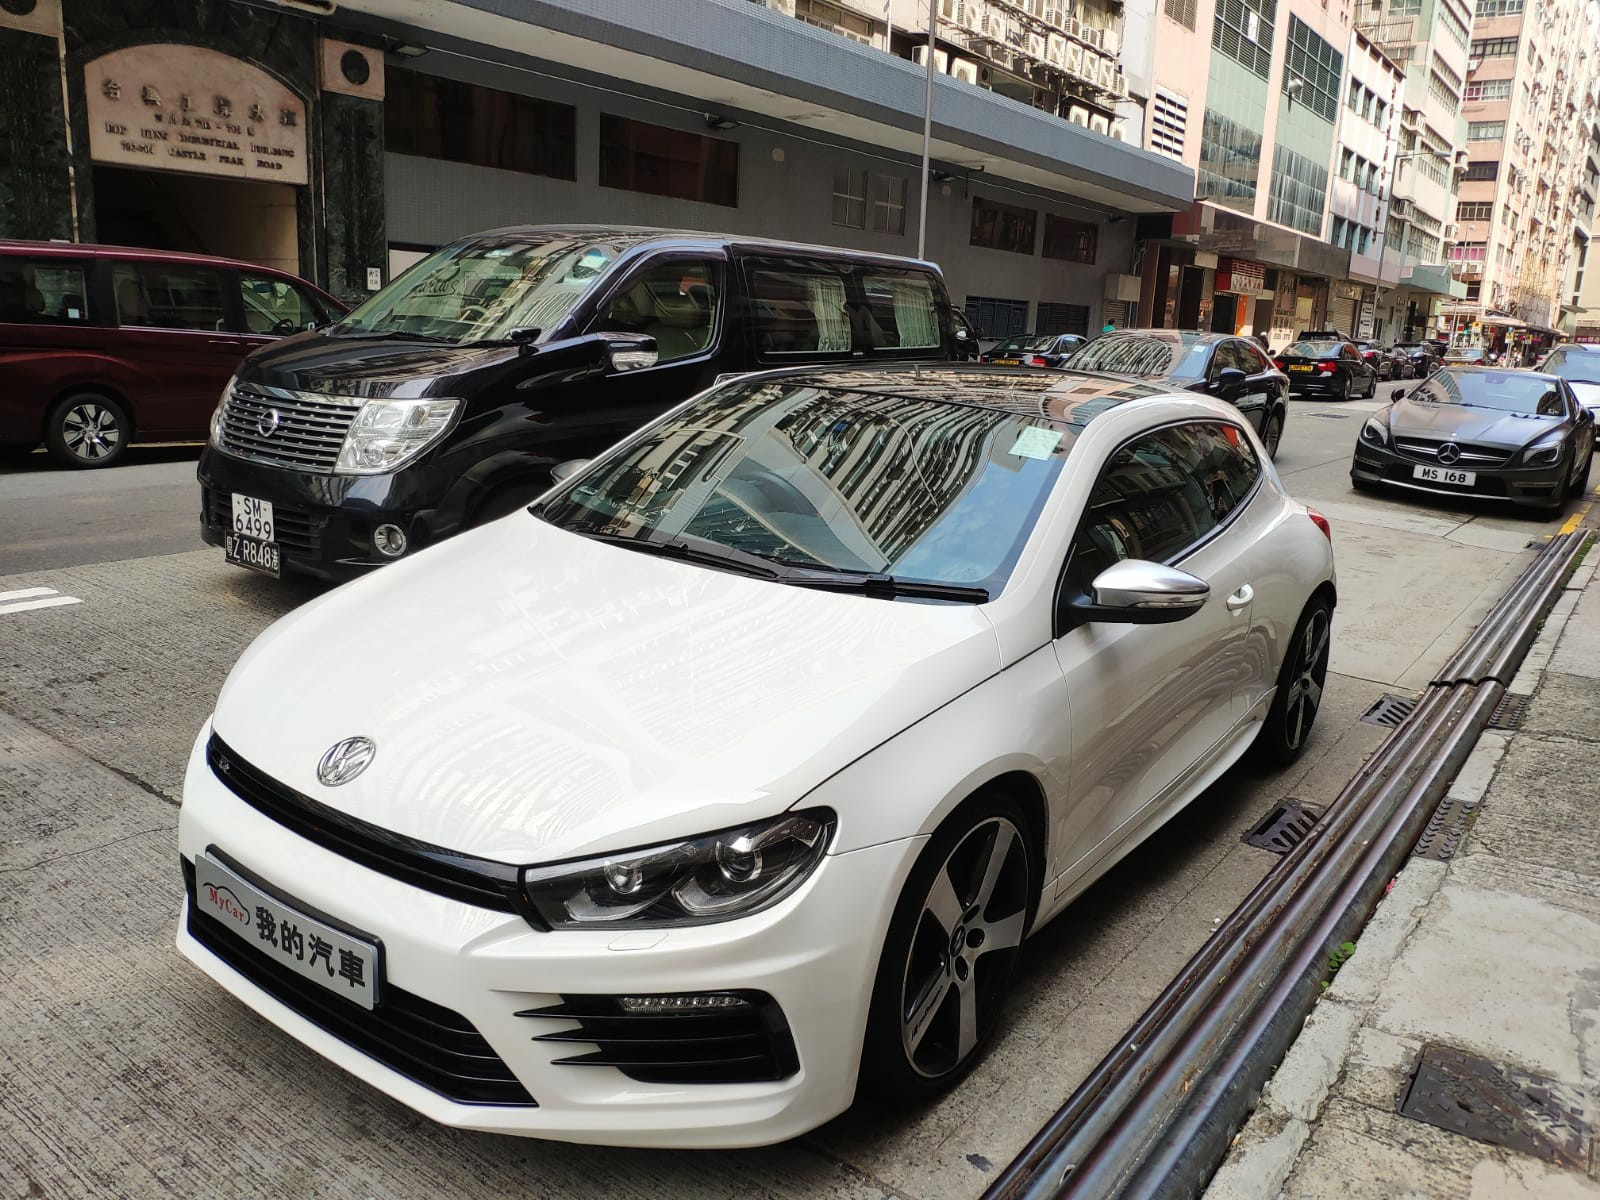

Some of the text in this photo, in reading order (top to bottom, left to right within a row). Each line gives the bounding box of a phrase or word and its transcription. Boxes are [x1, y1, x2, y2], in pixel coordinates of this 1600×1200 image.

[179, 133, 240, 151] INDUSTRIAL
[167, 148, 206, 161] CASTLE
[219, 155, 244, 166] PEAK
[256, 159, 283, 170] ROAD
[1422, 468, 1466, 483] MS 168
[243, 497, 262, 518] SM
[235, 513, 272, 540] 6499
[209, 887, 245, 922] MyCar
[255, 906, 366, 987] 我的汽車
